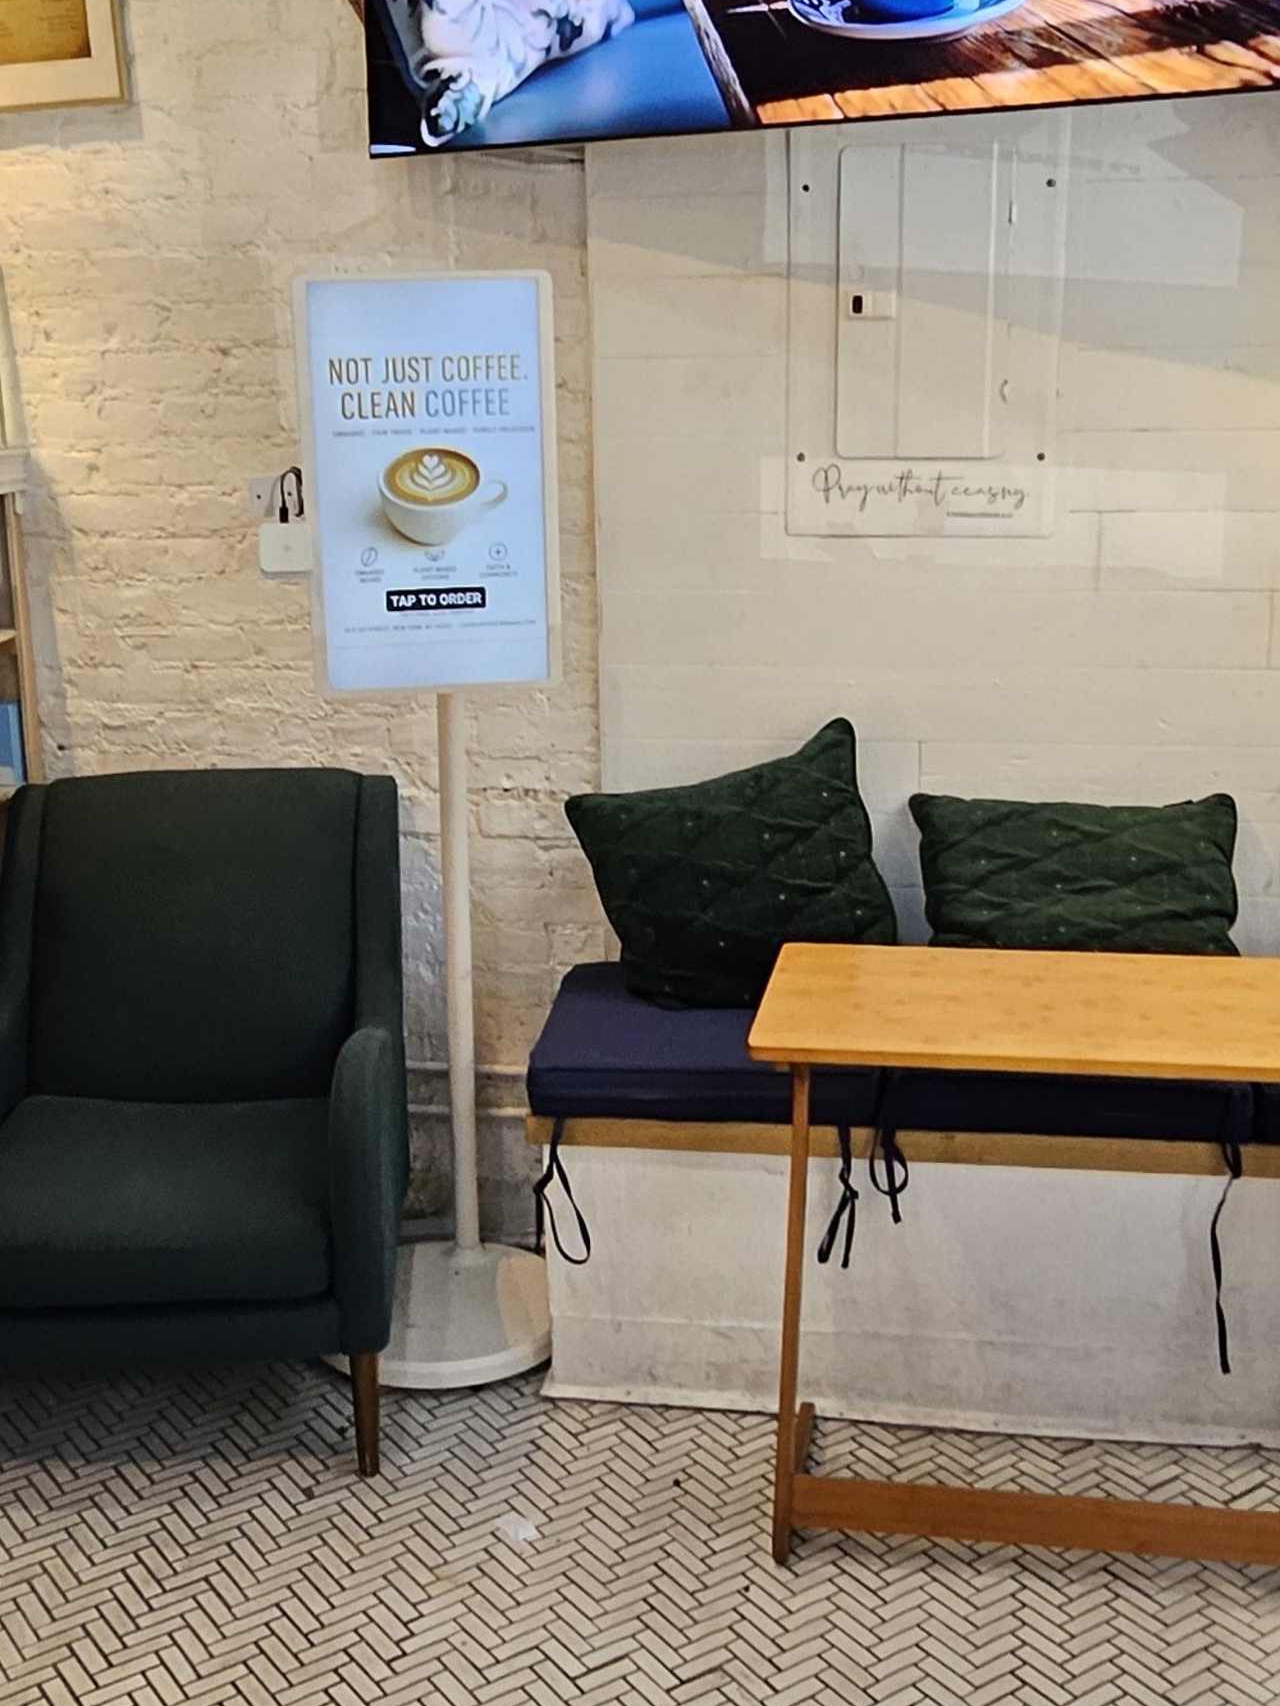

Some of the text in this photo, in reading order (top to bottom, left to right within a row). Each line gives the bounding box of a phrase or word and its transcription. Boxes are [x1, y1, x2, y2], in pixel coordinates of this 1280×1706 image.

[328, 357, 373, 385] NOT
[381, 356, 433, 384] JUST
[341, 388, 510, 420] CLEAN COFFEE
[390, 592, 484, 607] TAP TO ORDER
